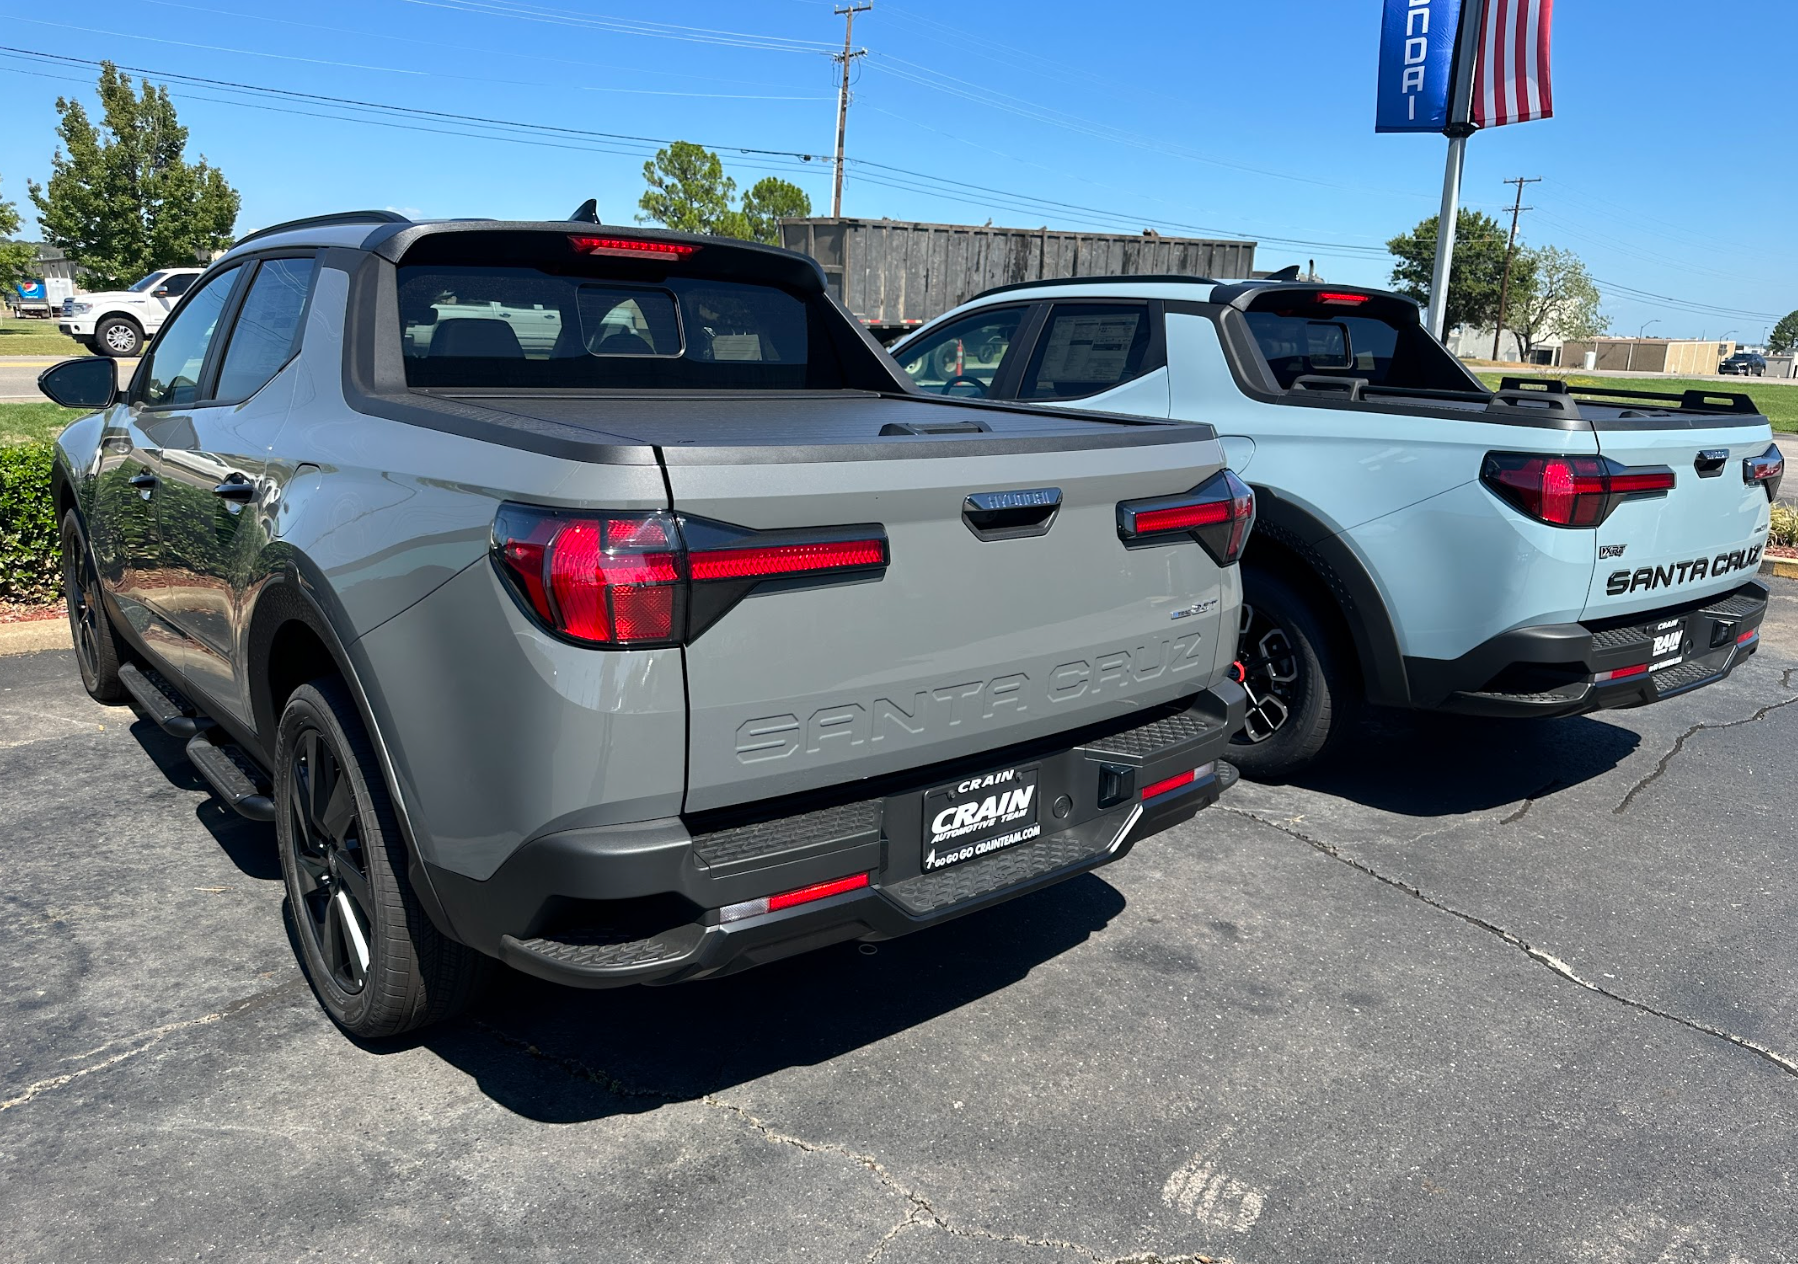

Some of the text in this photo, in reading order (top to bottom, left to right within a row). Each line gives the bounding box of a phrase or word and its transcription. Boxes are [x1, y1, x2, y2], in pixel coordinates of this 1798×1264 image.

[1402, 0, 1431, 120] NDAI
[1606, 544, 1763, 597] SANTA CRUZ
[1652, 629, 1684, 652] RAIN
[734, 671, 1031, 764] SANTA
[1047, 632, 1202, 703] CRUZ
[957, 769, 1015, 794] CRAIN
[930, 808, 1028, 844] AUTOMOTIVE TEAM
[931, 784, 1035, 834] CRAIN
[934, 825, 1041, 868] GO GO GO CRAINTEAM.COM
